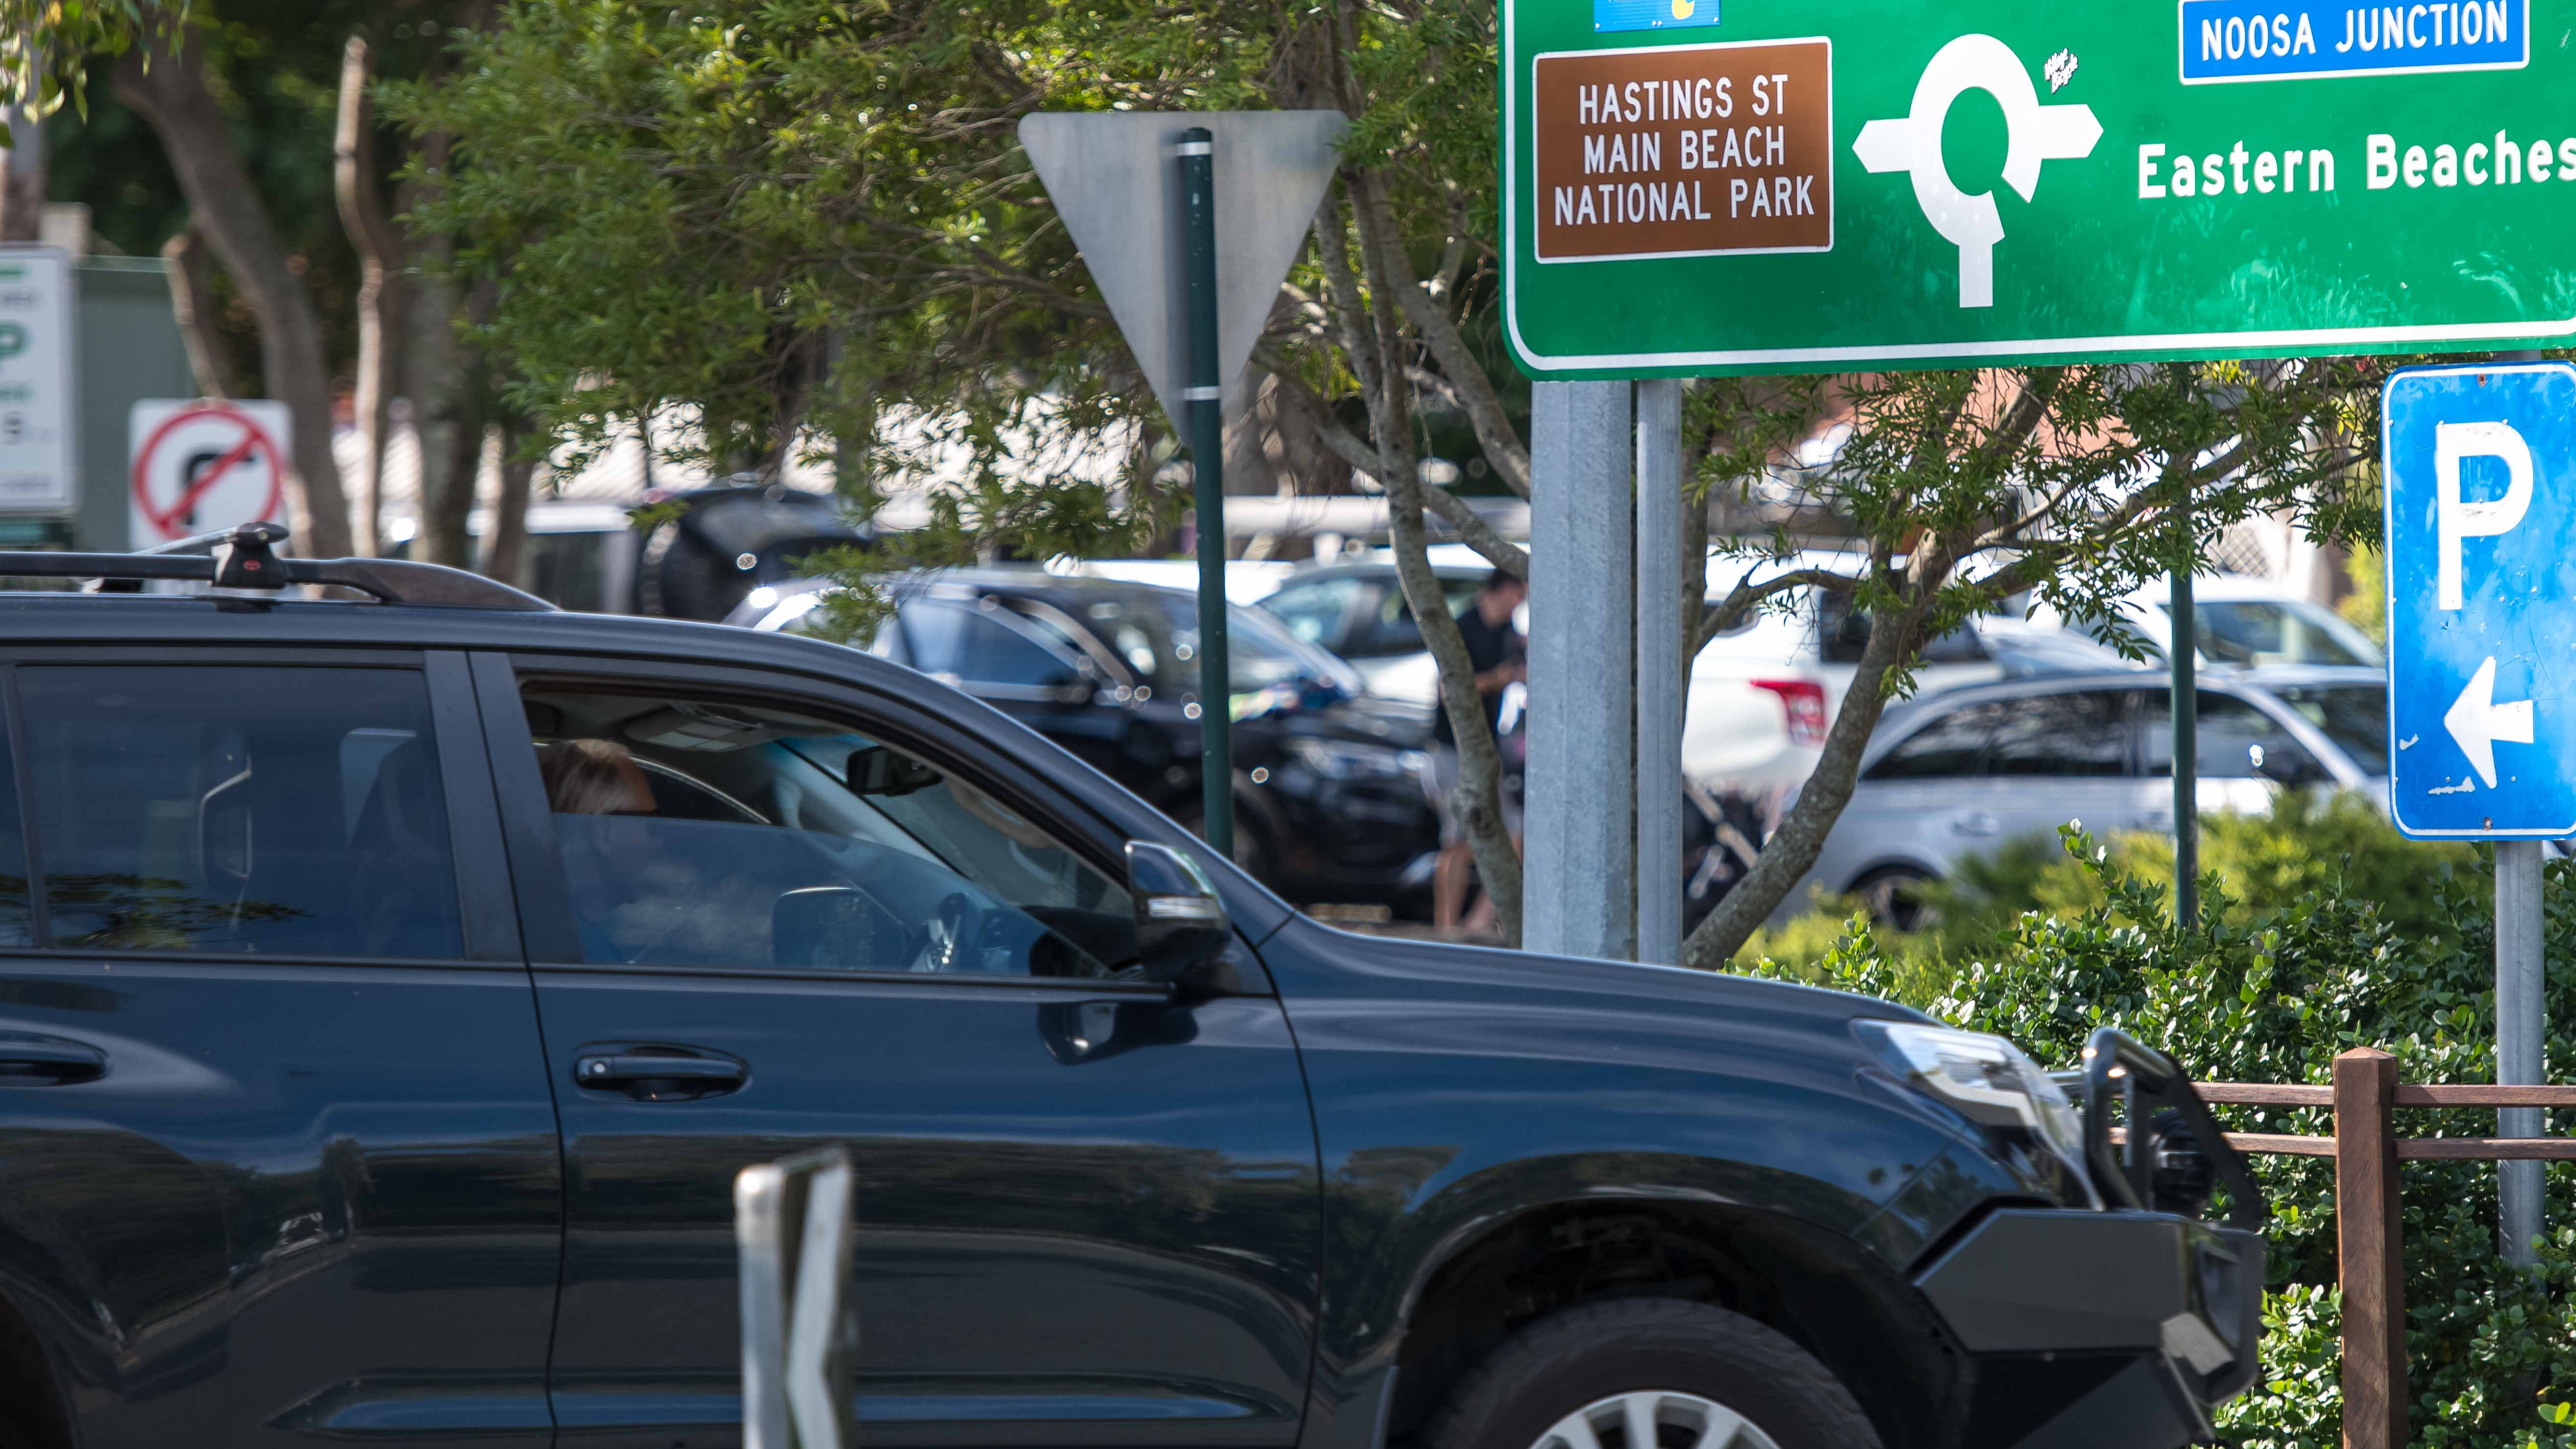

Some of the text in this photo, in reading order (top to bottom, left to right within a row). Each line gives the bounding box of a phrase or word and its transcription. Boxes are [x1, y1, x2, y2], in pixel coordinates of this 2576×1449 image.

[2202, 0, 2507, 61] NOOSA JUNCTION
[1580, 74, 1789, 124] HASTINGS ST
[1584, 125, 1784, 174] MAIN BEACH
[2138, 129, 2576, 199] Eastern Beaches
[1555, 175, 1814, 226] NATIONAL PARK
[2435, 421, 2534, 611] P
